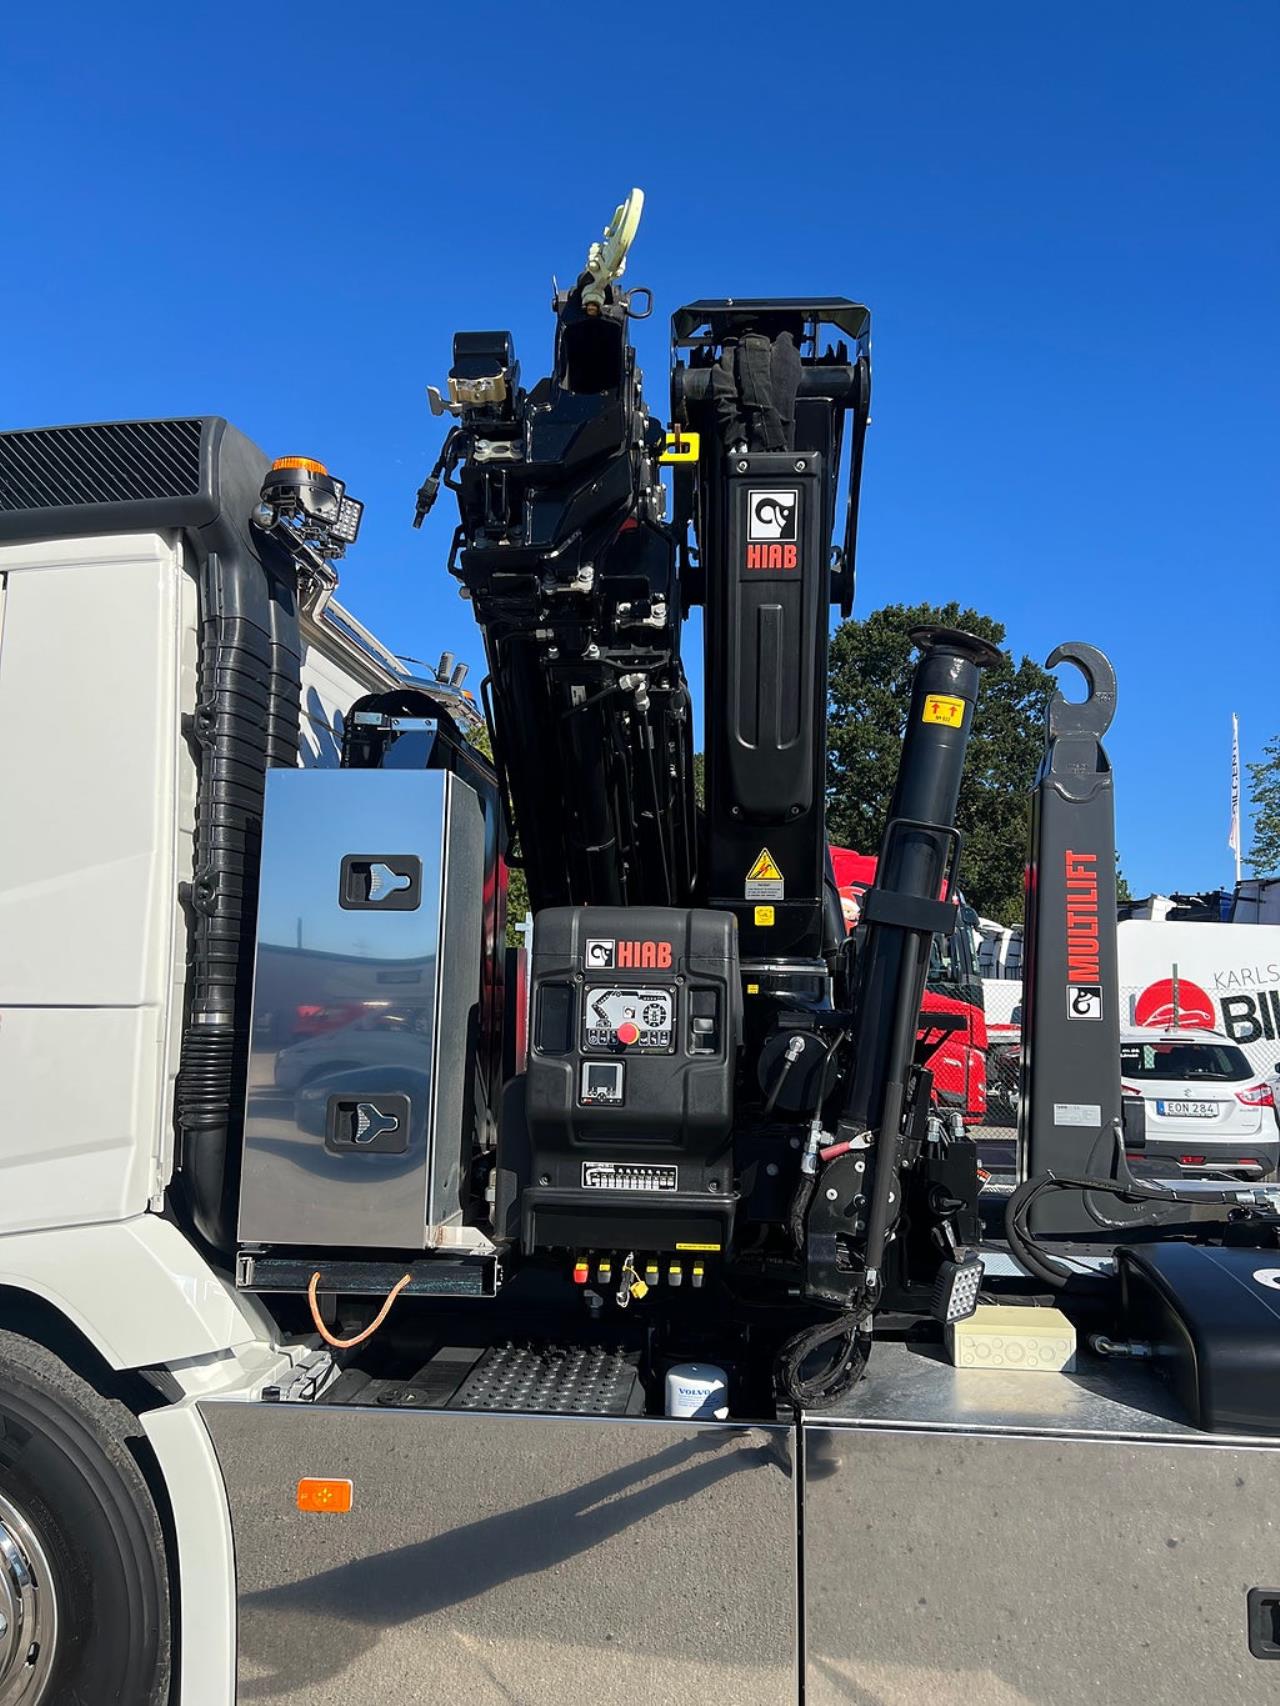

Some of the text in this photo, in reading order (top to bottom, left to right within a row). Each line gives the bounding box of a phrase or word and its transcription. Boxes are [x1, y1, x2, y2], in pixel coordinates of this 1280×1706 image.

[747, 544, 797, 569] HIAB
[1066, 850, 1100, 982] MULTILIFT
[618, 941, 672, 968] HIAB
[1214, 964, 1280, 990] KARLS
[1167, 1102, 1214, 1114] EON 284
[678, 1387, 711, 1397] VOLVO
